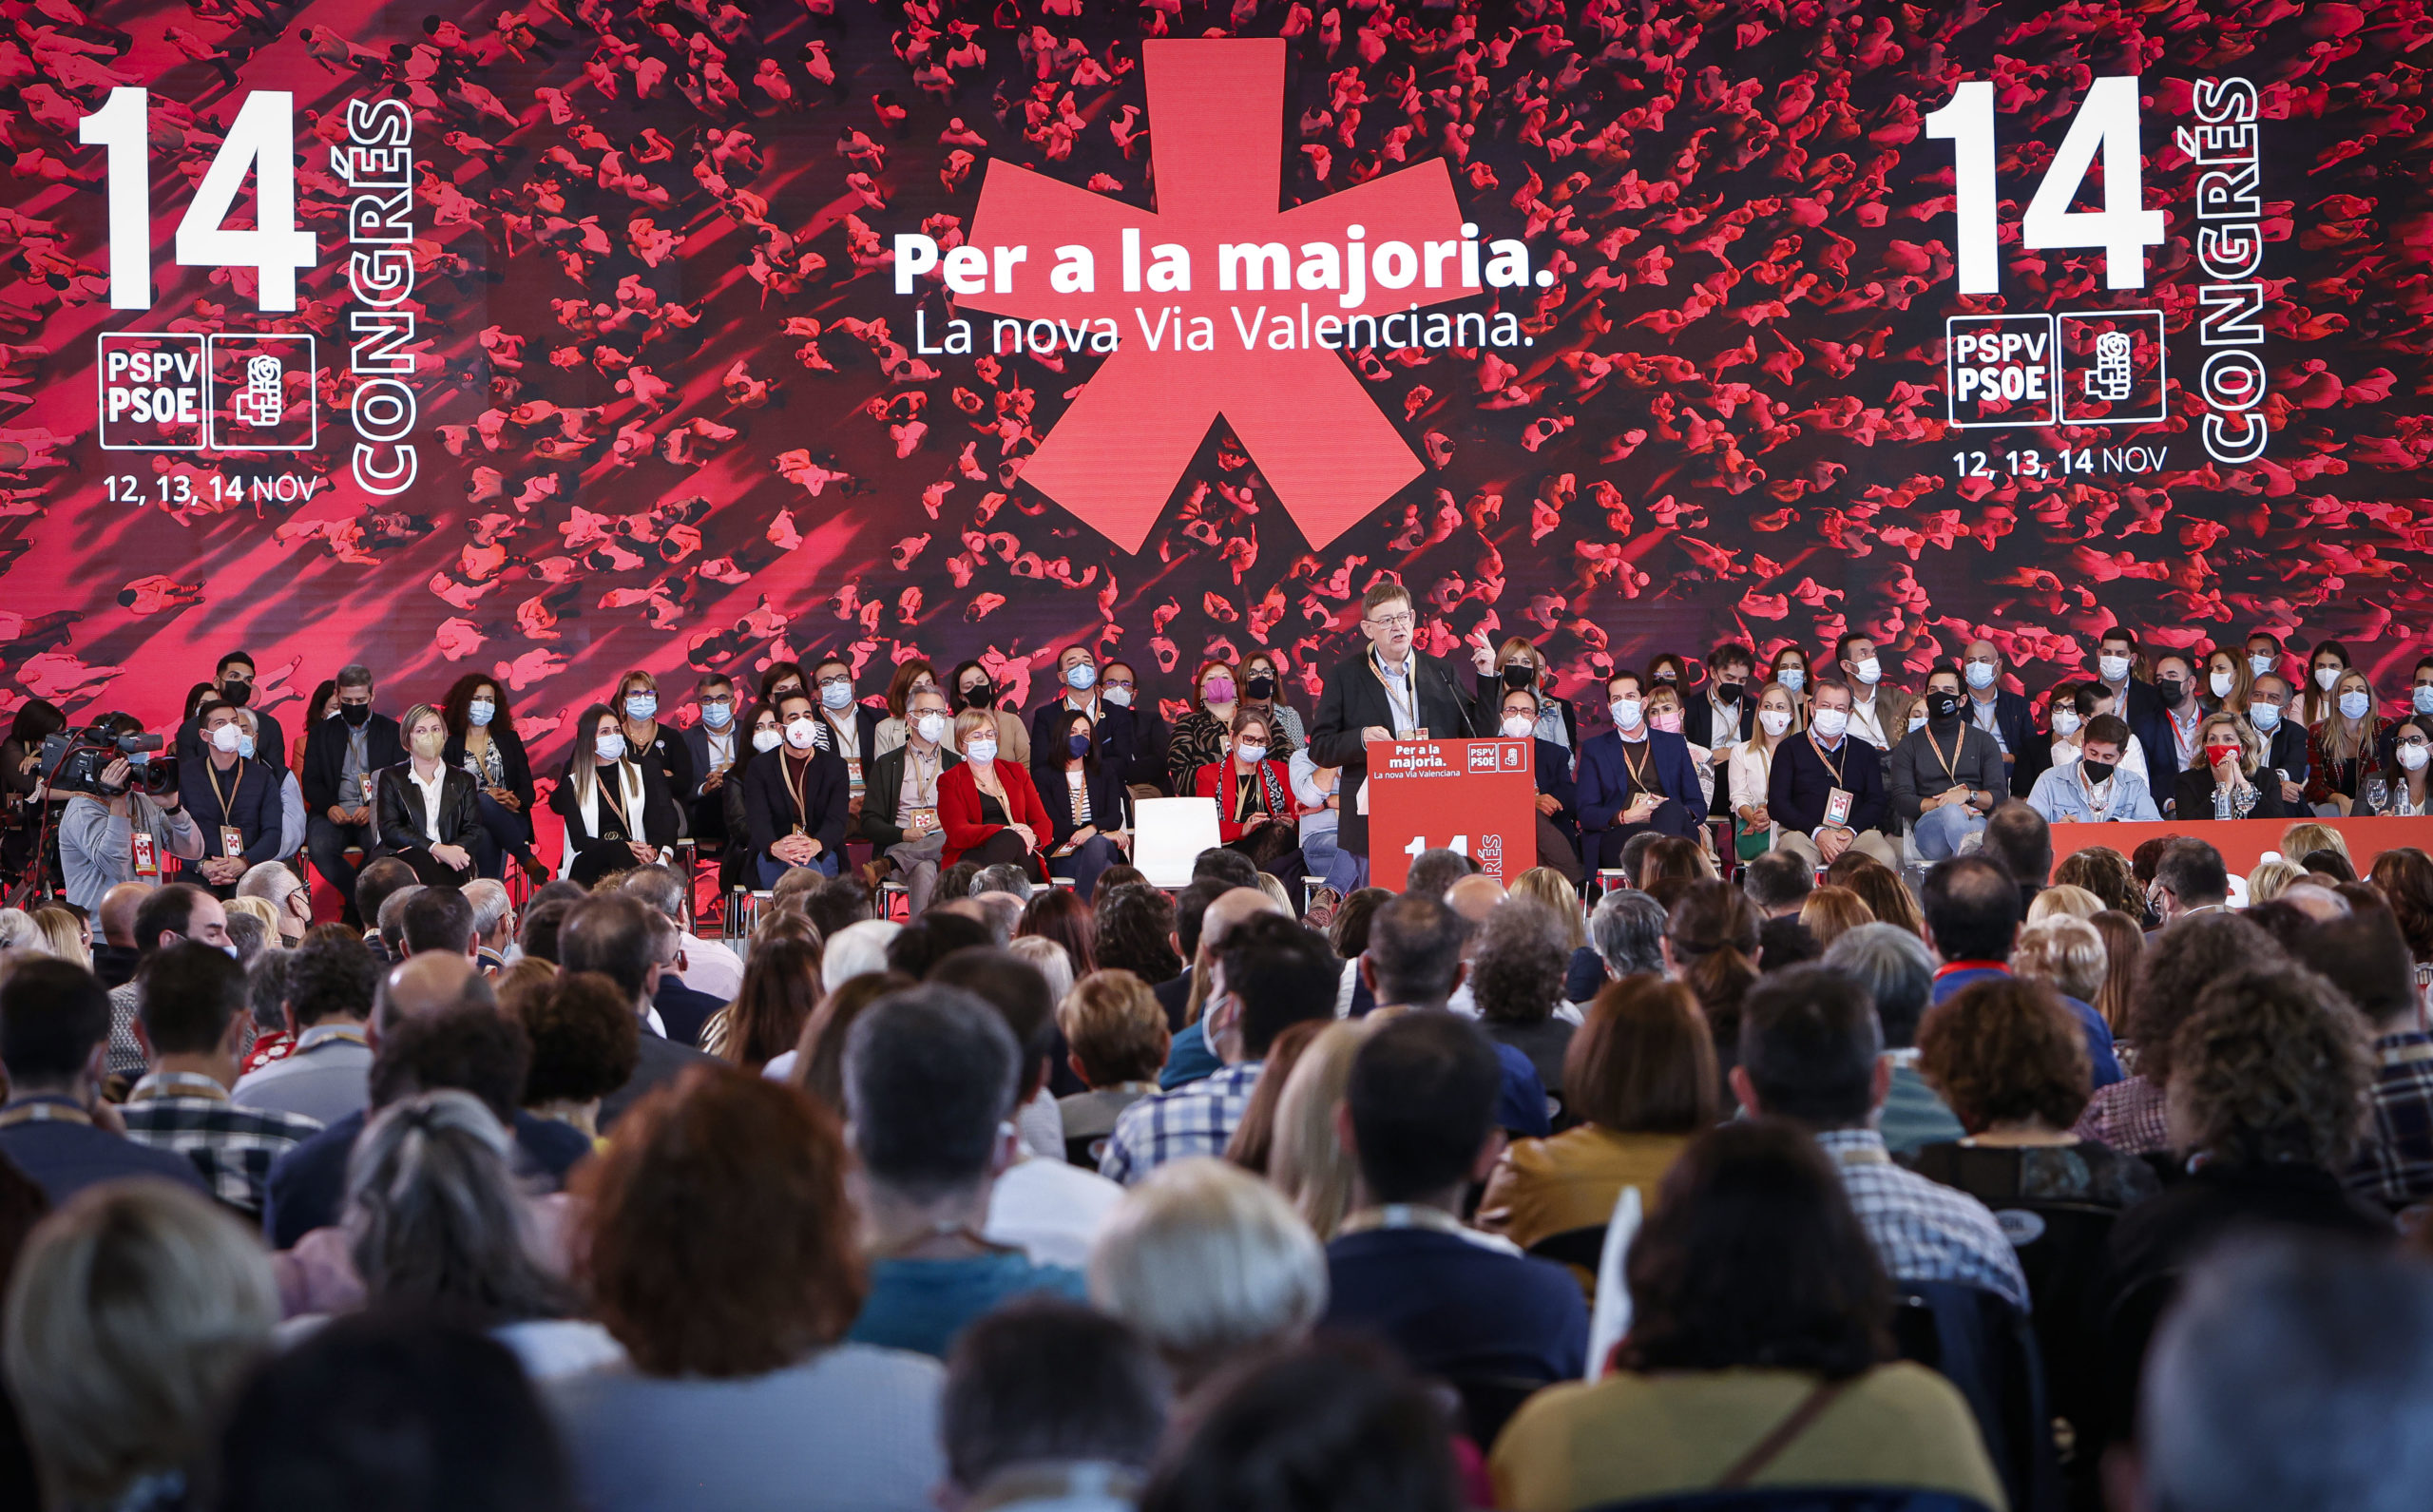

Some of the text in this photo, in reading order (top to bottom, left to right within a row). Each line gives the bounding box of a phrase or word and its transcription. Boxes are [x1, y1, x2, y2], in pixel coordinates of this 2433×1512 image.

[79, 86, 317, 312] 14
[1925, 75, 2165, 295] 14
[894, 223, 1554, 308] Per a la majoria.
[2176, 77, 2268, 464] CONGRÉS
[330, 98, 418, 496] CONGRÉS
[916, 302, 1533, 354] La nova Via Valenciana.
[1957, 332, 2048, 363] PSPV
[108, 352, 200, 383] PSPV
[1957, 366, 2046, 402] PSOE
[108, 387, 198, 423] PSOE
[1953, 446, 2168, 481] 12, 13, 14 NOV
[104, 474, 317, 507] 12, 13, 14 NOV
[1389, 755, 1447, 771] majoria.
[1395, 744, 1440, 756] Per a la
[1470, 748, 1495, 756] PSPV
[1470, 756, 1495, 767] PSOE
[1373, 771, 1384, 779] La
[1419, 769, 1461, 778] Valenciana
